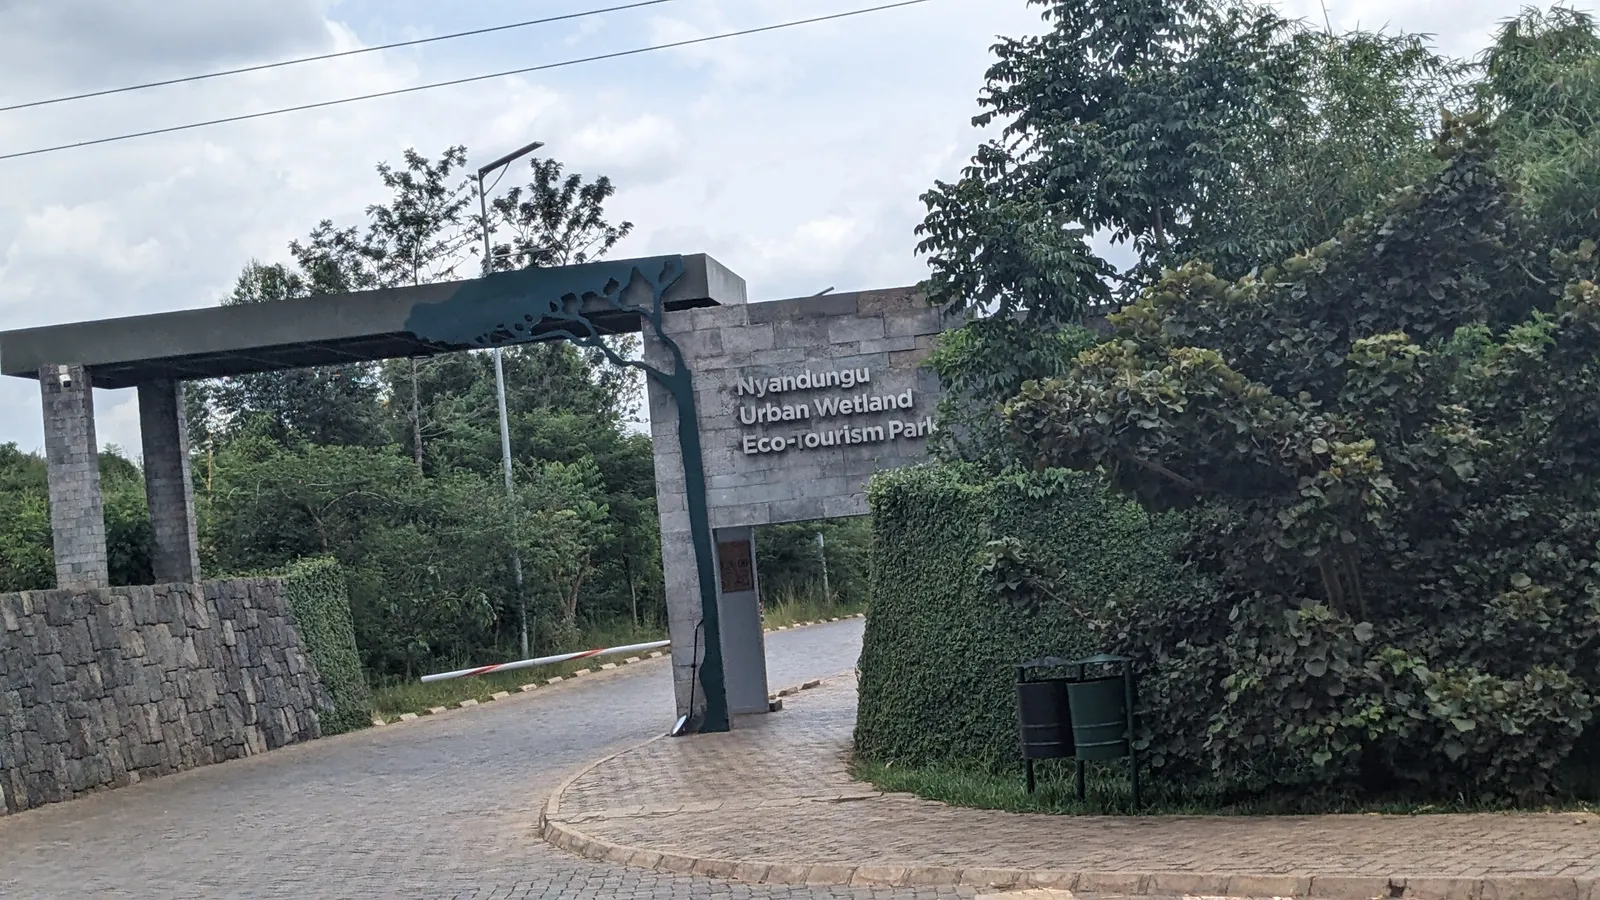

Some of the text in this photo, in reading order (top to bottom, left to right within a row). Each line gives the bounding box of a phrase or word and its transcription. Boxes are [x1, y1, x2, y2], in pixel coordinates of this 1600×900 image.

[737, 367, 870, 398] Nyandungu
[740, 388, 913, 425] Urban Wetland
[742, 424, 884, 454] Eco-Tourism
